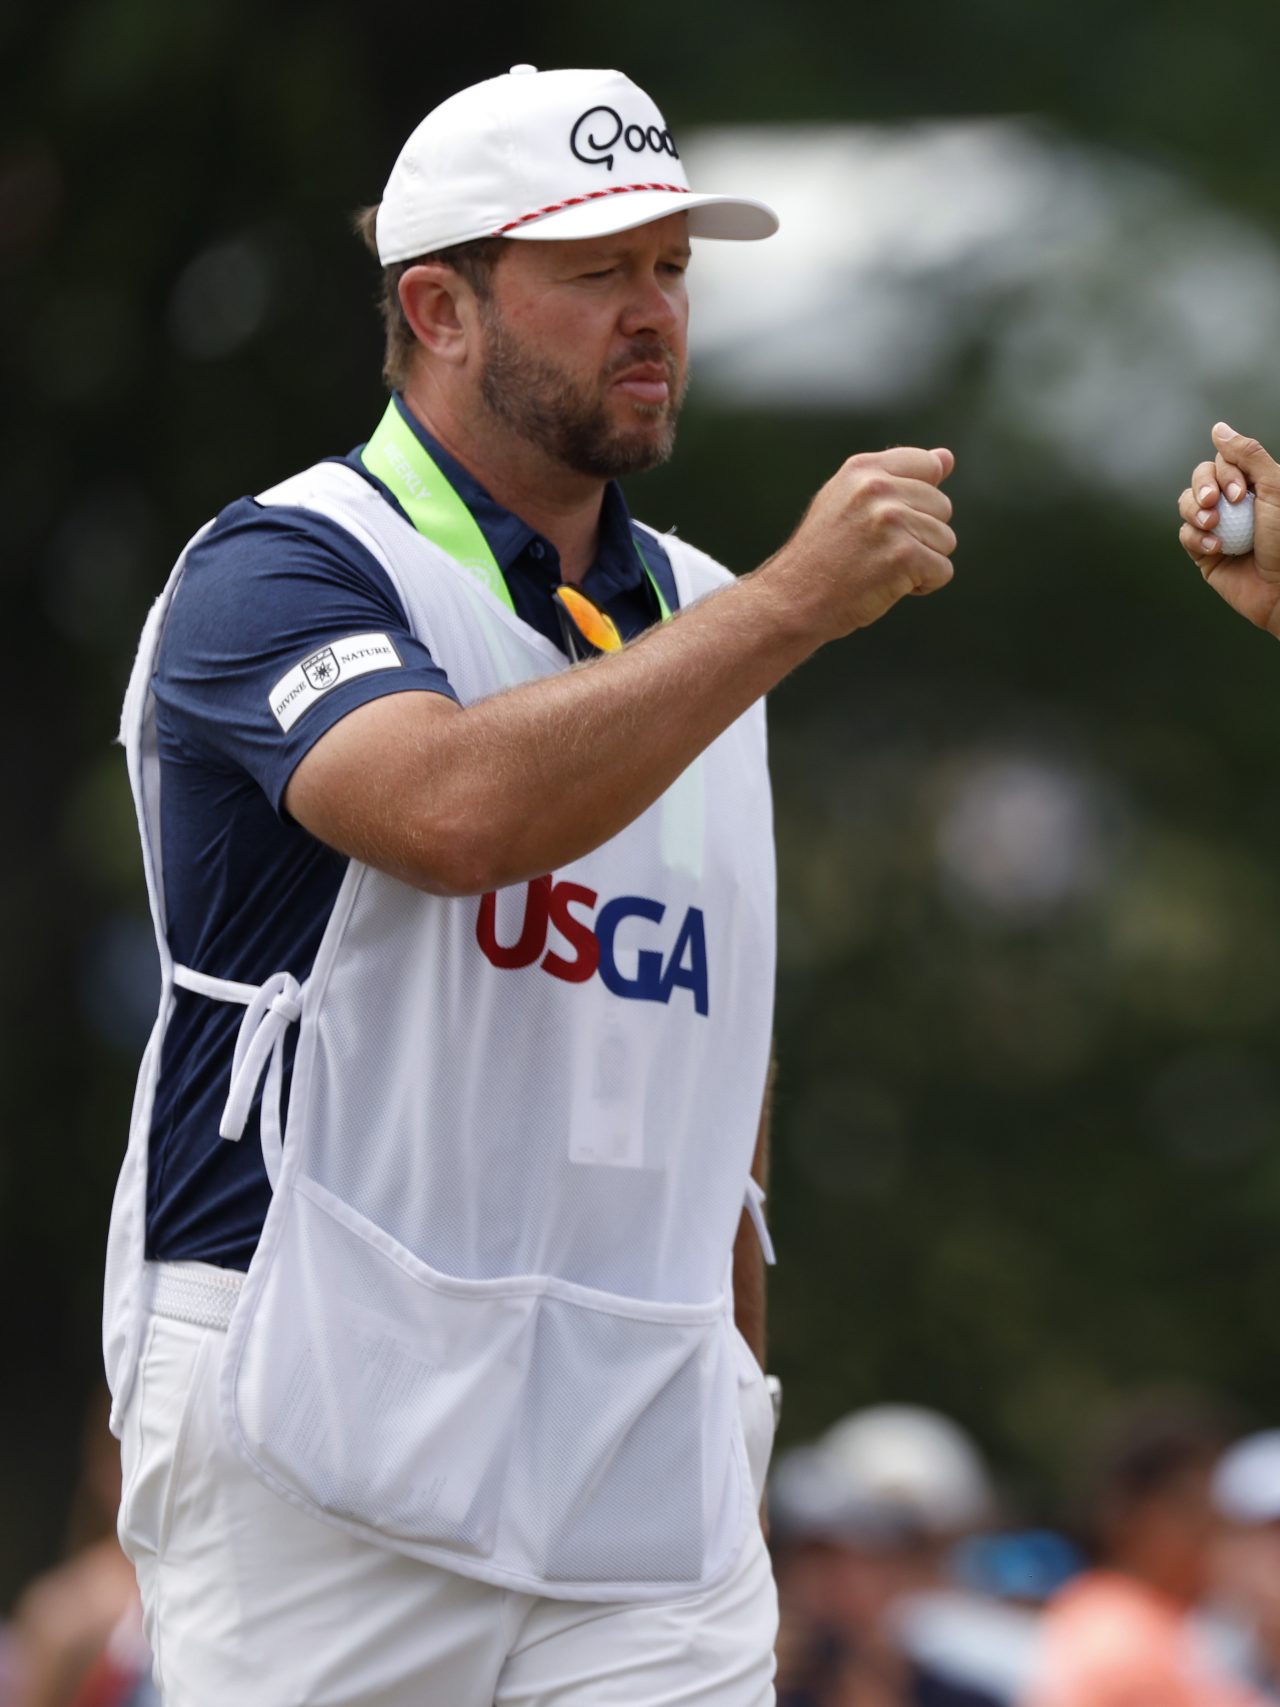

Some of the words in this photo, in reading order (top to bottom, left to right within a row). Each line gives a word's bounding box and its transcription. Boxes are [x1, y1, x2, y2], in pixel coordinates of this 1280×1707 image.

[276, 681, 307, 715] DIVINE
[341, 647, 391, 664] NATURE
[476, 873, 709, 1018] USGA
